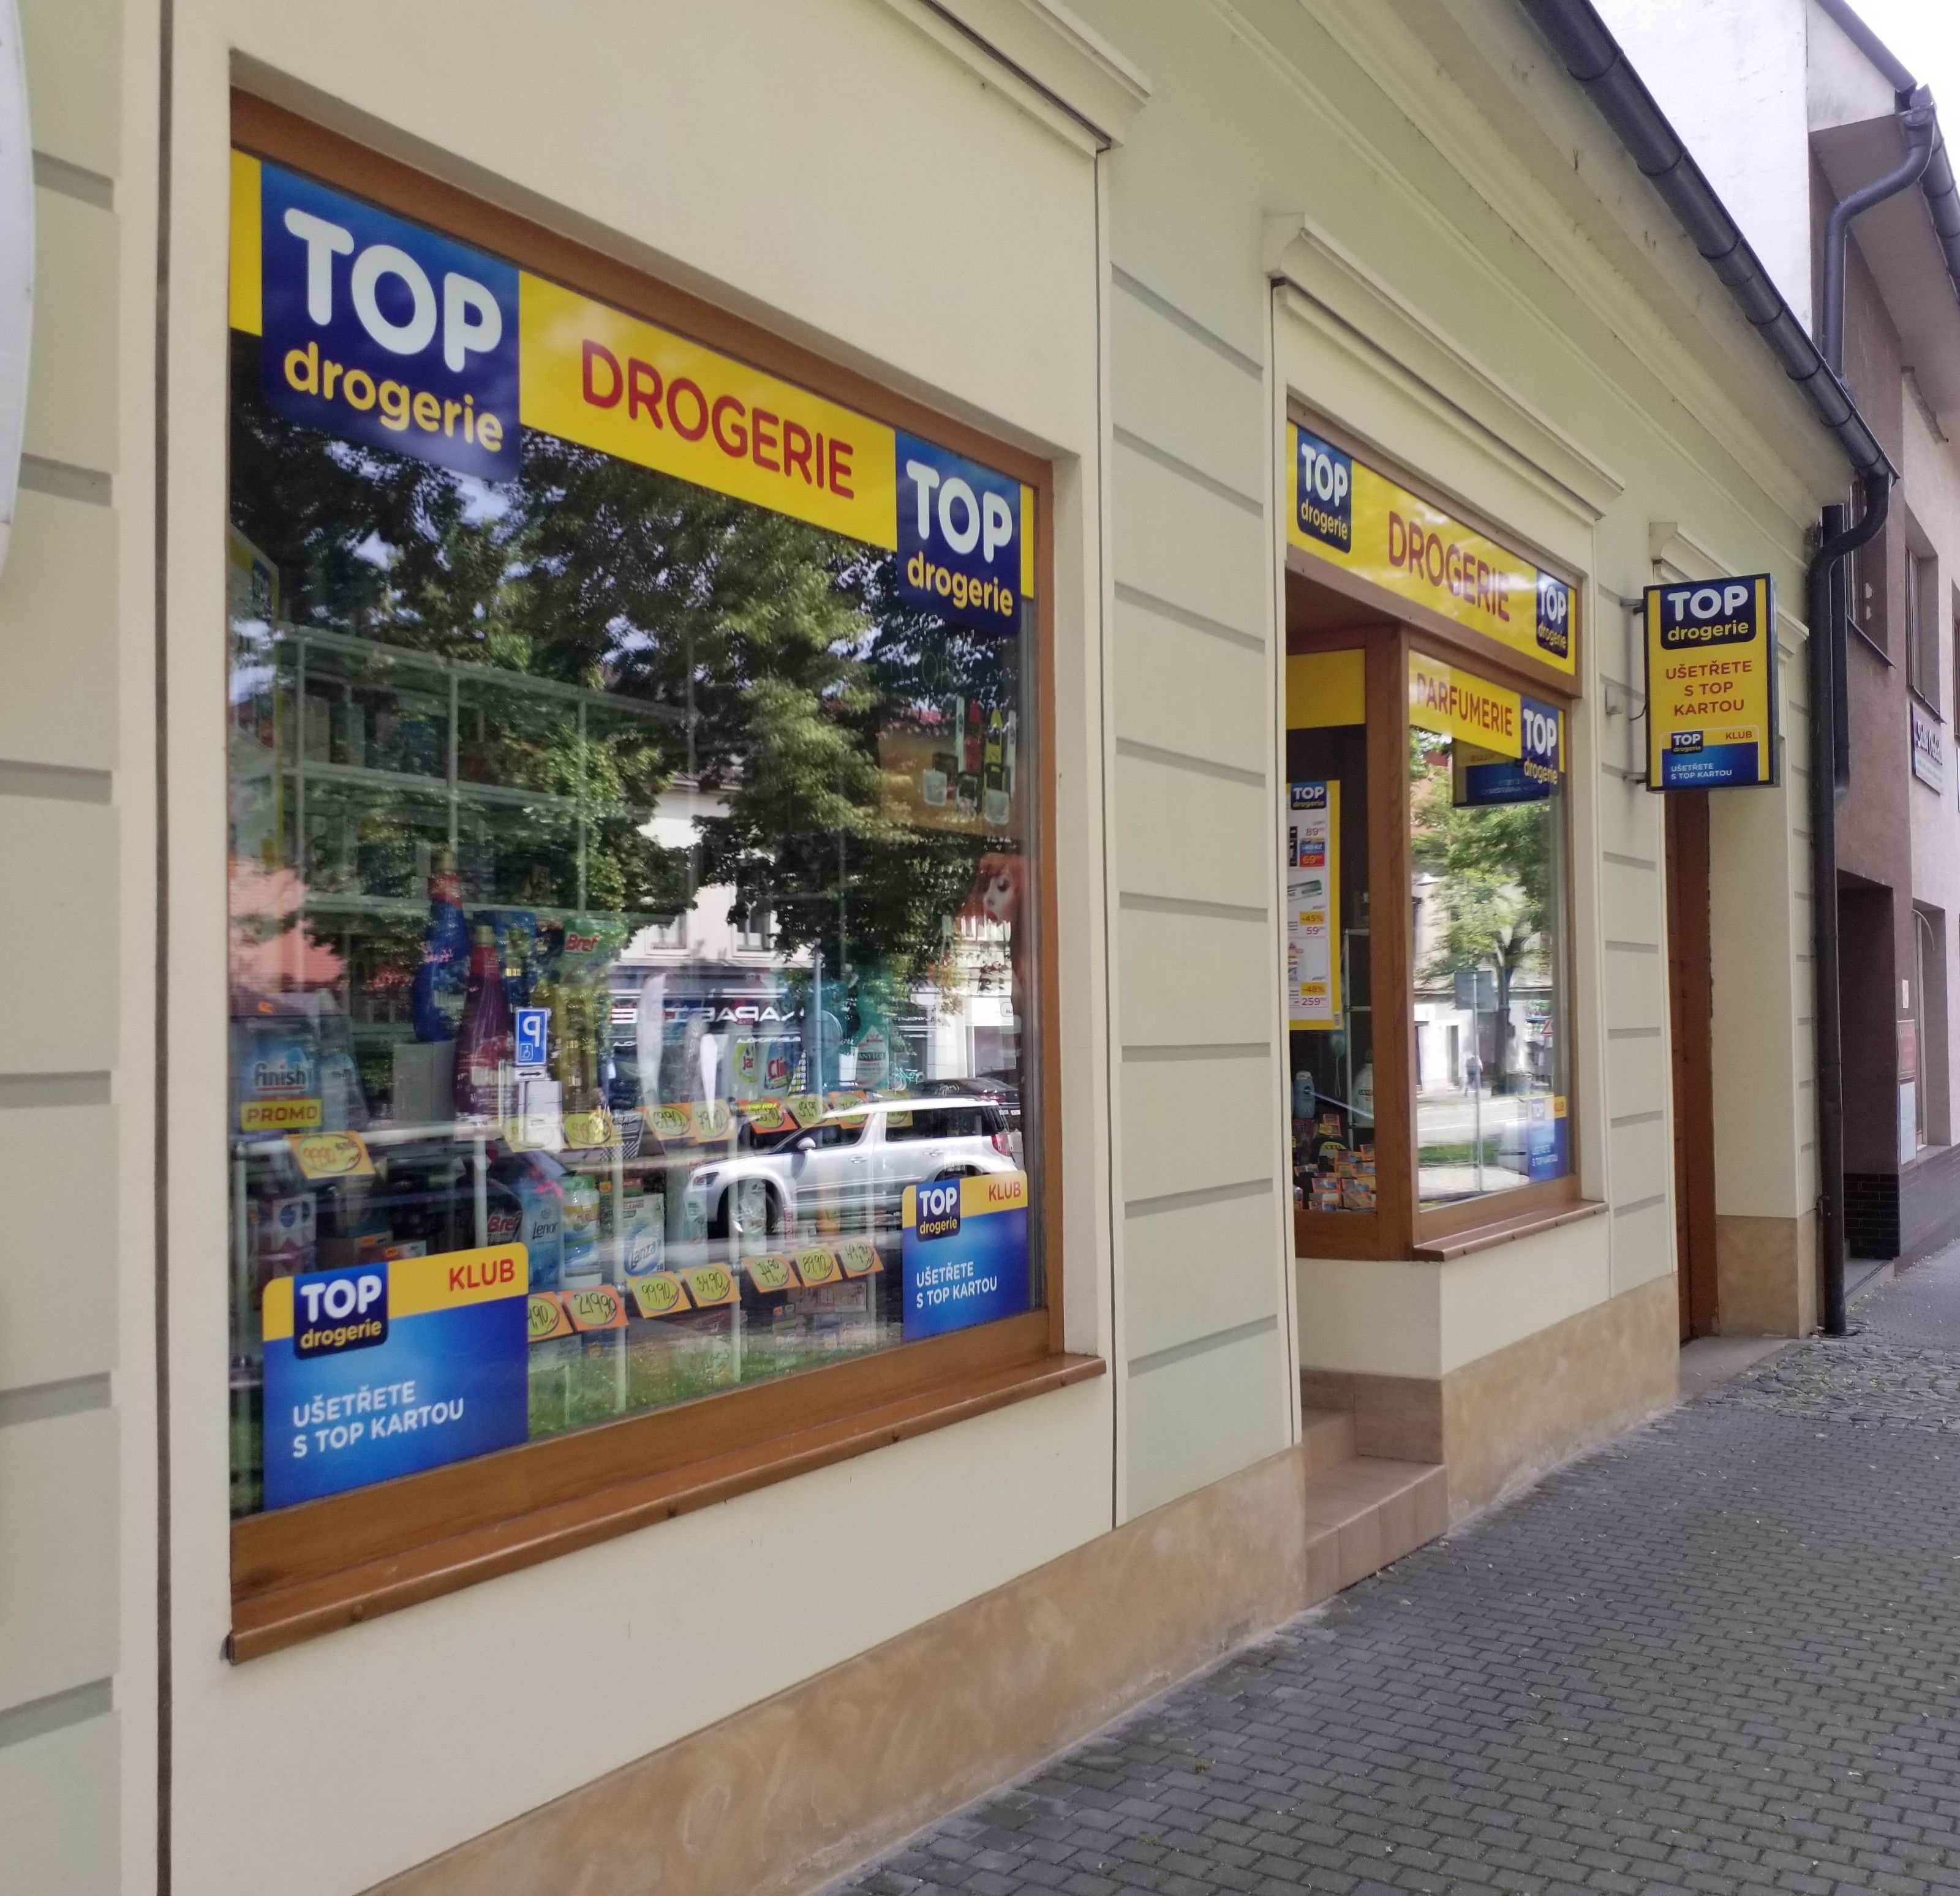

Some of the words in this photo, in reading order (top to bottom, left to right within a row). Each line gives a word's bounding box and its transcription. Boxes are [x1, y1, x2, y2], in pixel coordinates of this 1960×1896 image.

[284, 208, 502, 372] TOP
[284, 341, 503, 452] drogerie
[582, 339, 855, 499] DROGERIE
[1302, 443, 1348, 506] TOP
[906, 459, 1012, 563] TOP
[1301, 499, 1348, 540] drogerie
[1389, 511, 1510, 622] DROGERIE
[907, 552, 1013, 617] drogerie
[1539, 581, 1567, 625] TOP
[1667, 585, 1748, 622] TOP
[1538, 620, 1566, 649] drogerie
[1667, 620, 1749, 641] drogerie
[1666, 660, 1752, 680] UŠETŘETE
[1684, 685, 1694, 697] S
[1700, 681, 1734, 695] TOP
[1417, 672, 1512, 737] PARFUMERIE
[1674, 699, 1744, 717] KARTOU
[1523, 709, 1558, 758] TOP
[1673, 734, 1701, 746] TOP
[1725, 731, 1752, 740] KLUB
[1524, 757, 1558, 785] drogerie
[1671, 762, 1714, 772] UŠETŘETE
[1697, 769, 1732, 778] KARTOU
[1293, 786, 1324, 800] TOP
[1303, 856, 1315, 864] 69
[565, 933, 601, 952] Bref
[1302, 998, 1321, 1006] 259
[254, 1062, 306, 1086] finish
[247, 1105, 318, 1123] PROMO
[919, 1187, 957, 1217] TOP
[989, 1181, 1021, 1202] KLUB
[533, 1221, 558, 1240] Lenor
[919, 1216, 957, 1235] drogerie
[449, 1258, 516, 1292] KLUB
[803, 1255, 827, 1274] 89,90
[916, 1261, 974, 1287] UŠETŘETE
[642, 1283, 671, 1304] 99,90
[696, 1271, 723, 1294] 34,90
[916, 1293, 923, 1309] S
[927, 1287, 950, 1306] TOP
[953, 1276, 998, 1301] KARTOU
[300, 1274, 382, 1323] TOP
[301, 1319, 382, 1349] drogerie
[293, 1380, 416, 1428] UŠETŘETE
[293, 1435, 307, 1459] S
[316, 1422, 364, 1453] TOP
[371, 1398, 464, 1440] KARTOU
